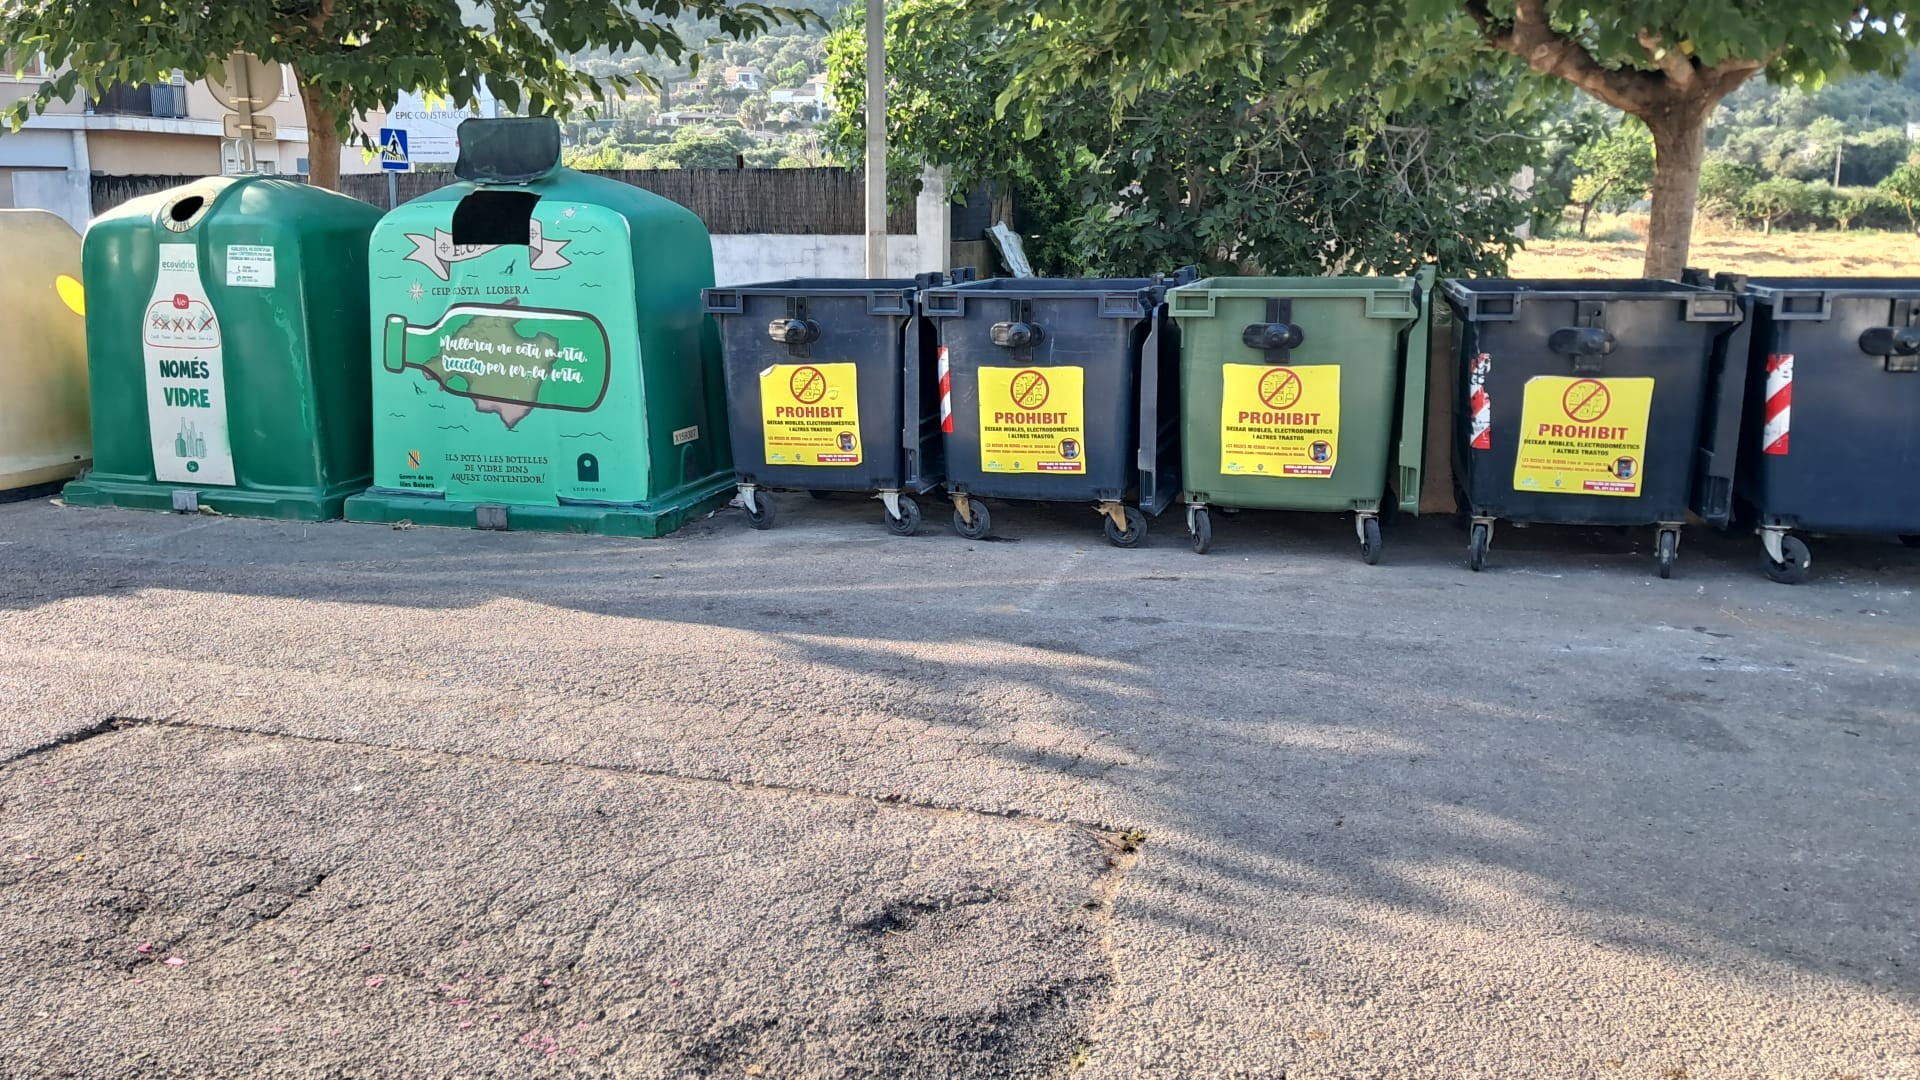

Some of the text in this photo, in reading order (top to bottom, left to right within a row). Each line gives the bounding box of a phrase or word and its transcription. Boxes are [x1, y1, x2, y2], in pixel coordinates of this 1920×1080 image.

[395, 111, 413, 120] EPIC
[162, 260, 195, 269] ecovidrio
[431, 287, 451, 296] CEIP
[486, 286, 530, 295] LLOBERA
[440, 335, 494, 354] Mallorca
[496, 343, 512, 355] no
[159, 356, 210, 379] NOMÉS
[442, 355, 485, 375] recicla
[486, 362, 506, 375] per
[163, 387, 211, 408] VIDRE
[775, 406, 844, 418] PROHIBIT
[994, 412, 1068, 424] PROHIBIT
[1238, 411, 1320, 425] PROHIBIT
[1538, 423, 1629, 440] PROHIBIT
[445, 454, 459, 462] ELS
[461, 454, 482, 462] POTS
[489, 455, 504, 463] LES
[506, 456, 548, 464] BOTELLES
[464, 464, 529, 473] DE VIDRE DINS
[451, 472, 546, 485] AQUEST CONTENIDOR!
